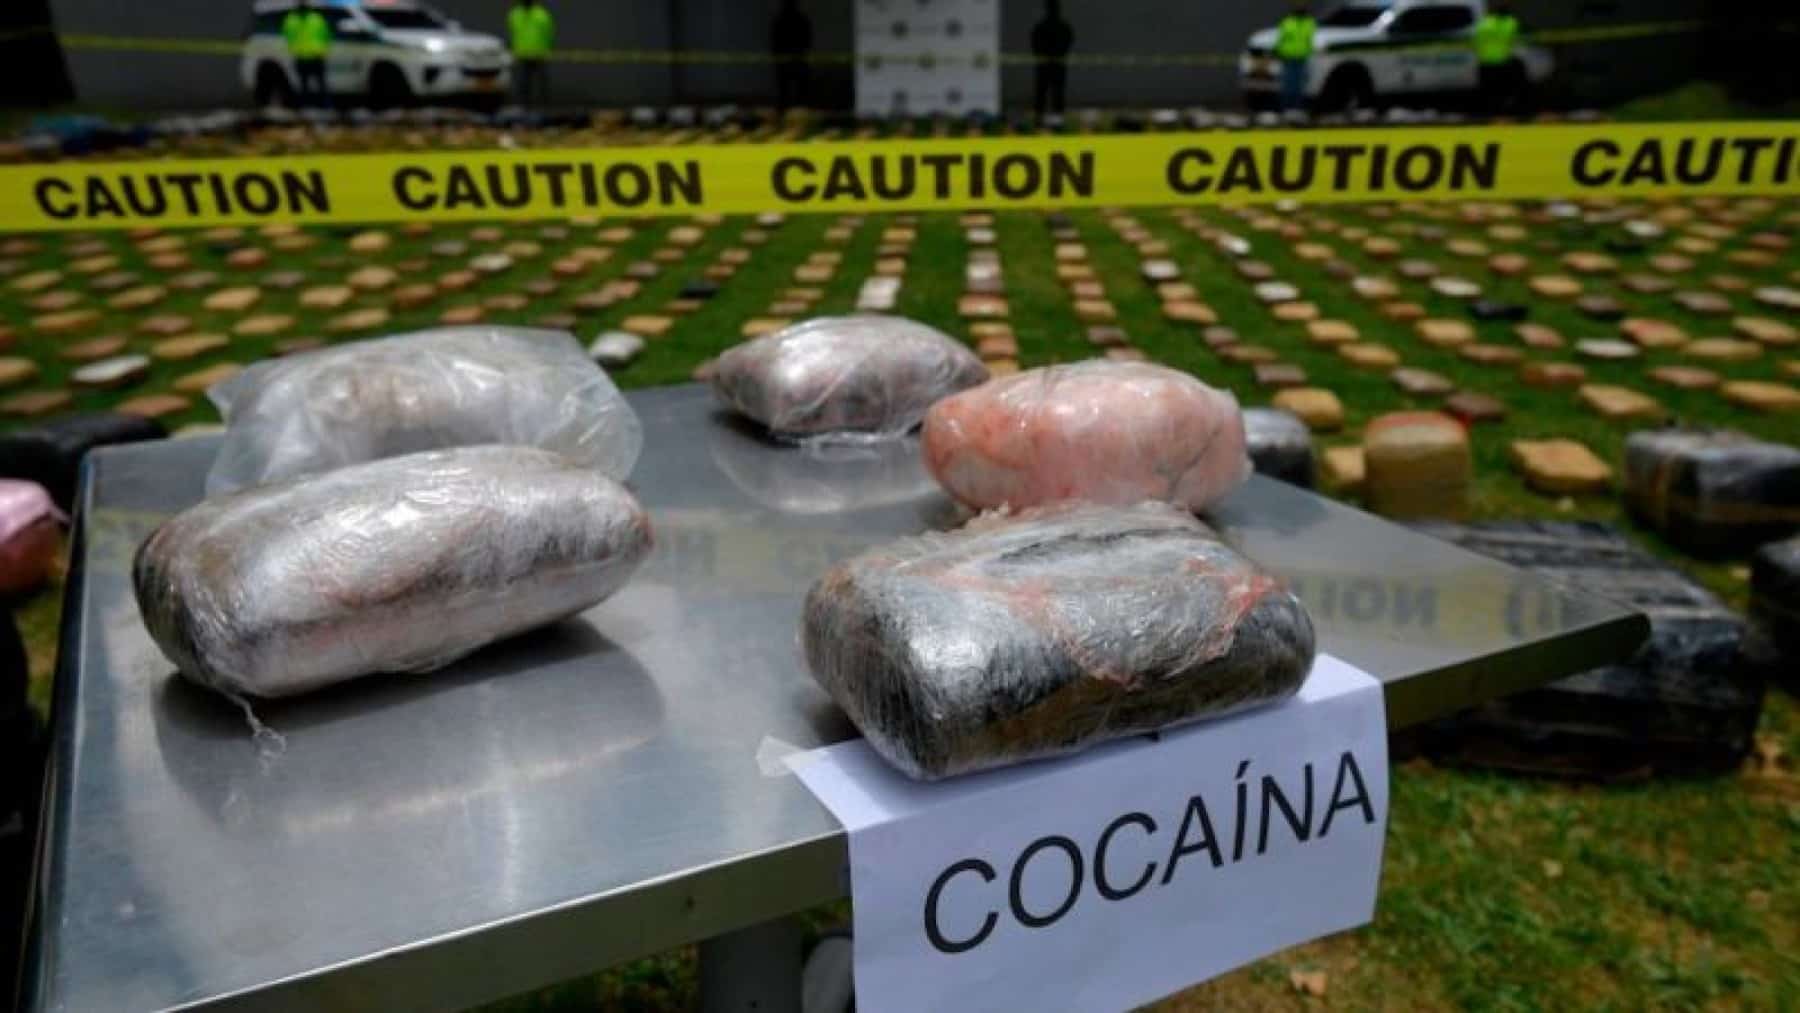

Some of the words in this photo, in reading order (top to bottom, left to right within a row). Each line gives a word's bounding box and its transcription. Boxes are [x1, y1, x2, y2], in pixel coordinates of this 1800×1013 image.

[34, 170, 330, 220] CAUTION
[392, 160, 702, 212] CAUTION
[771, 152, 1094, 202] CAUTION
[1167, 143, 1499, 194] CAUTION
[1571, 137, 1800, 188] CAUTI
[924, 752, 1375, 954] COCAÍNA
